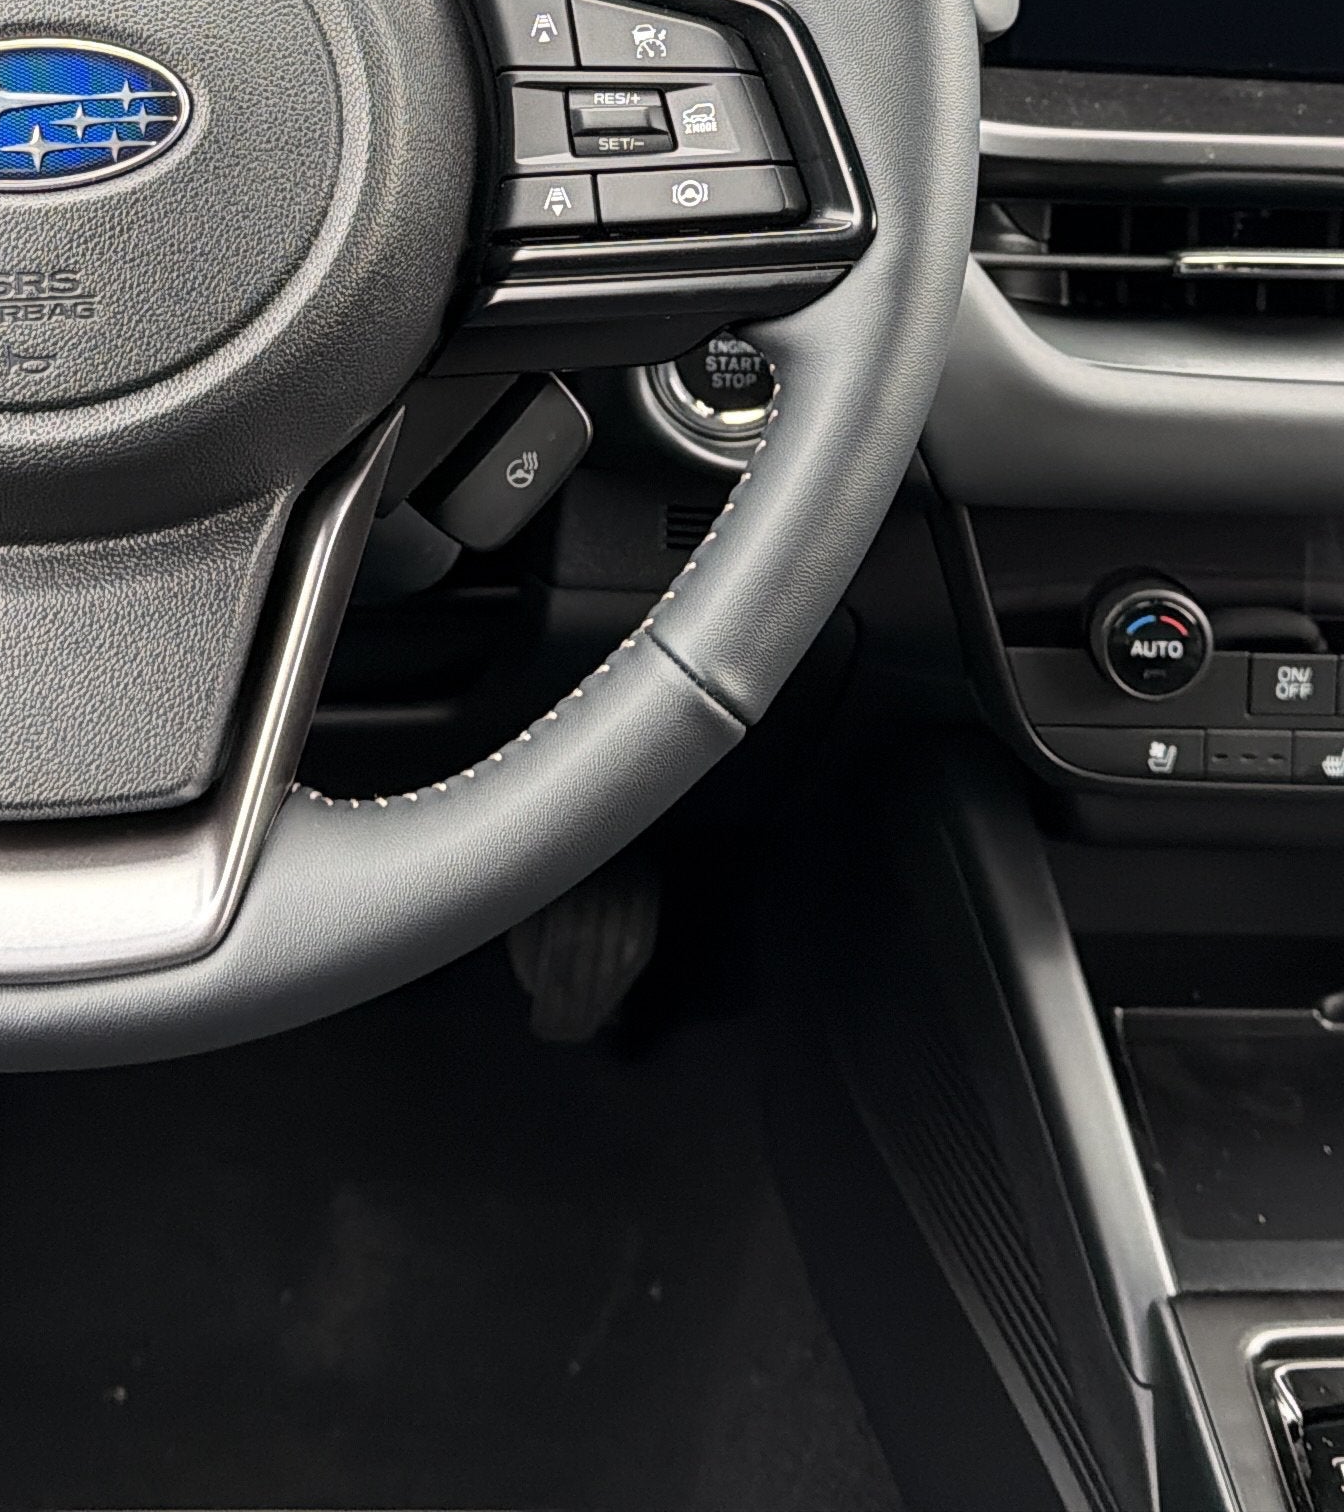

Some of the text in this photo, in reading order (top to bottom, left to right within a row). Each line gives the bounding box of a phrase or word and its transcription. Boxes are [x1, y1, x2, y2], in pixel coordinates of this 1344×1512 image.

[705, 355, 762, 372] START
[711, 372, 758, 389] STOP
[1130, 639, 1185, 659] AUTO
[1277, 665, 1313, 682] ON/
[1275, 682, 1313, 701] OFF
